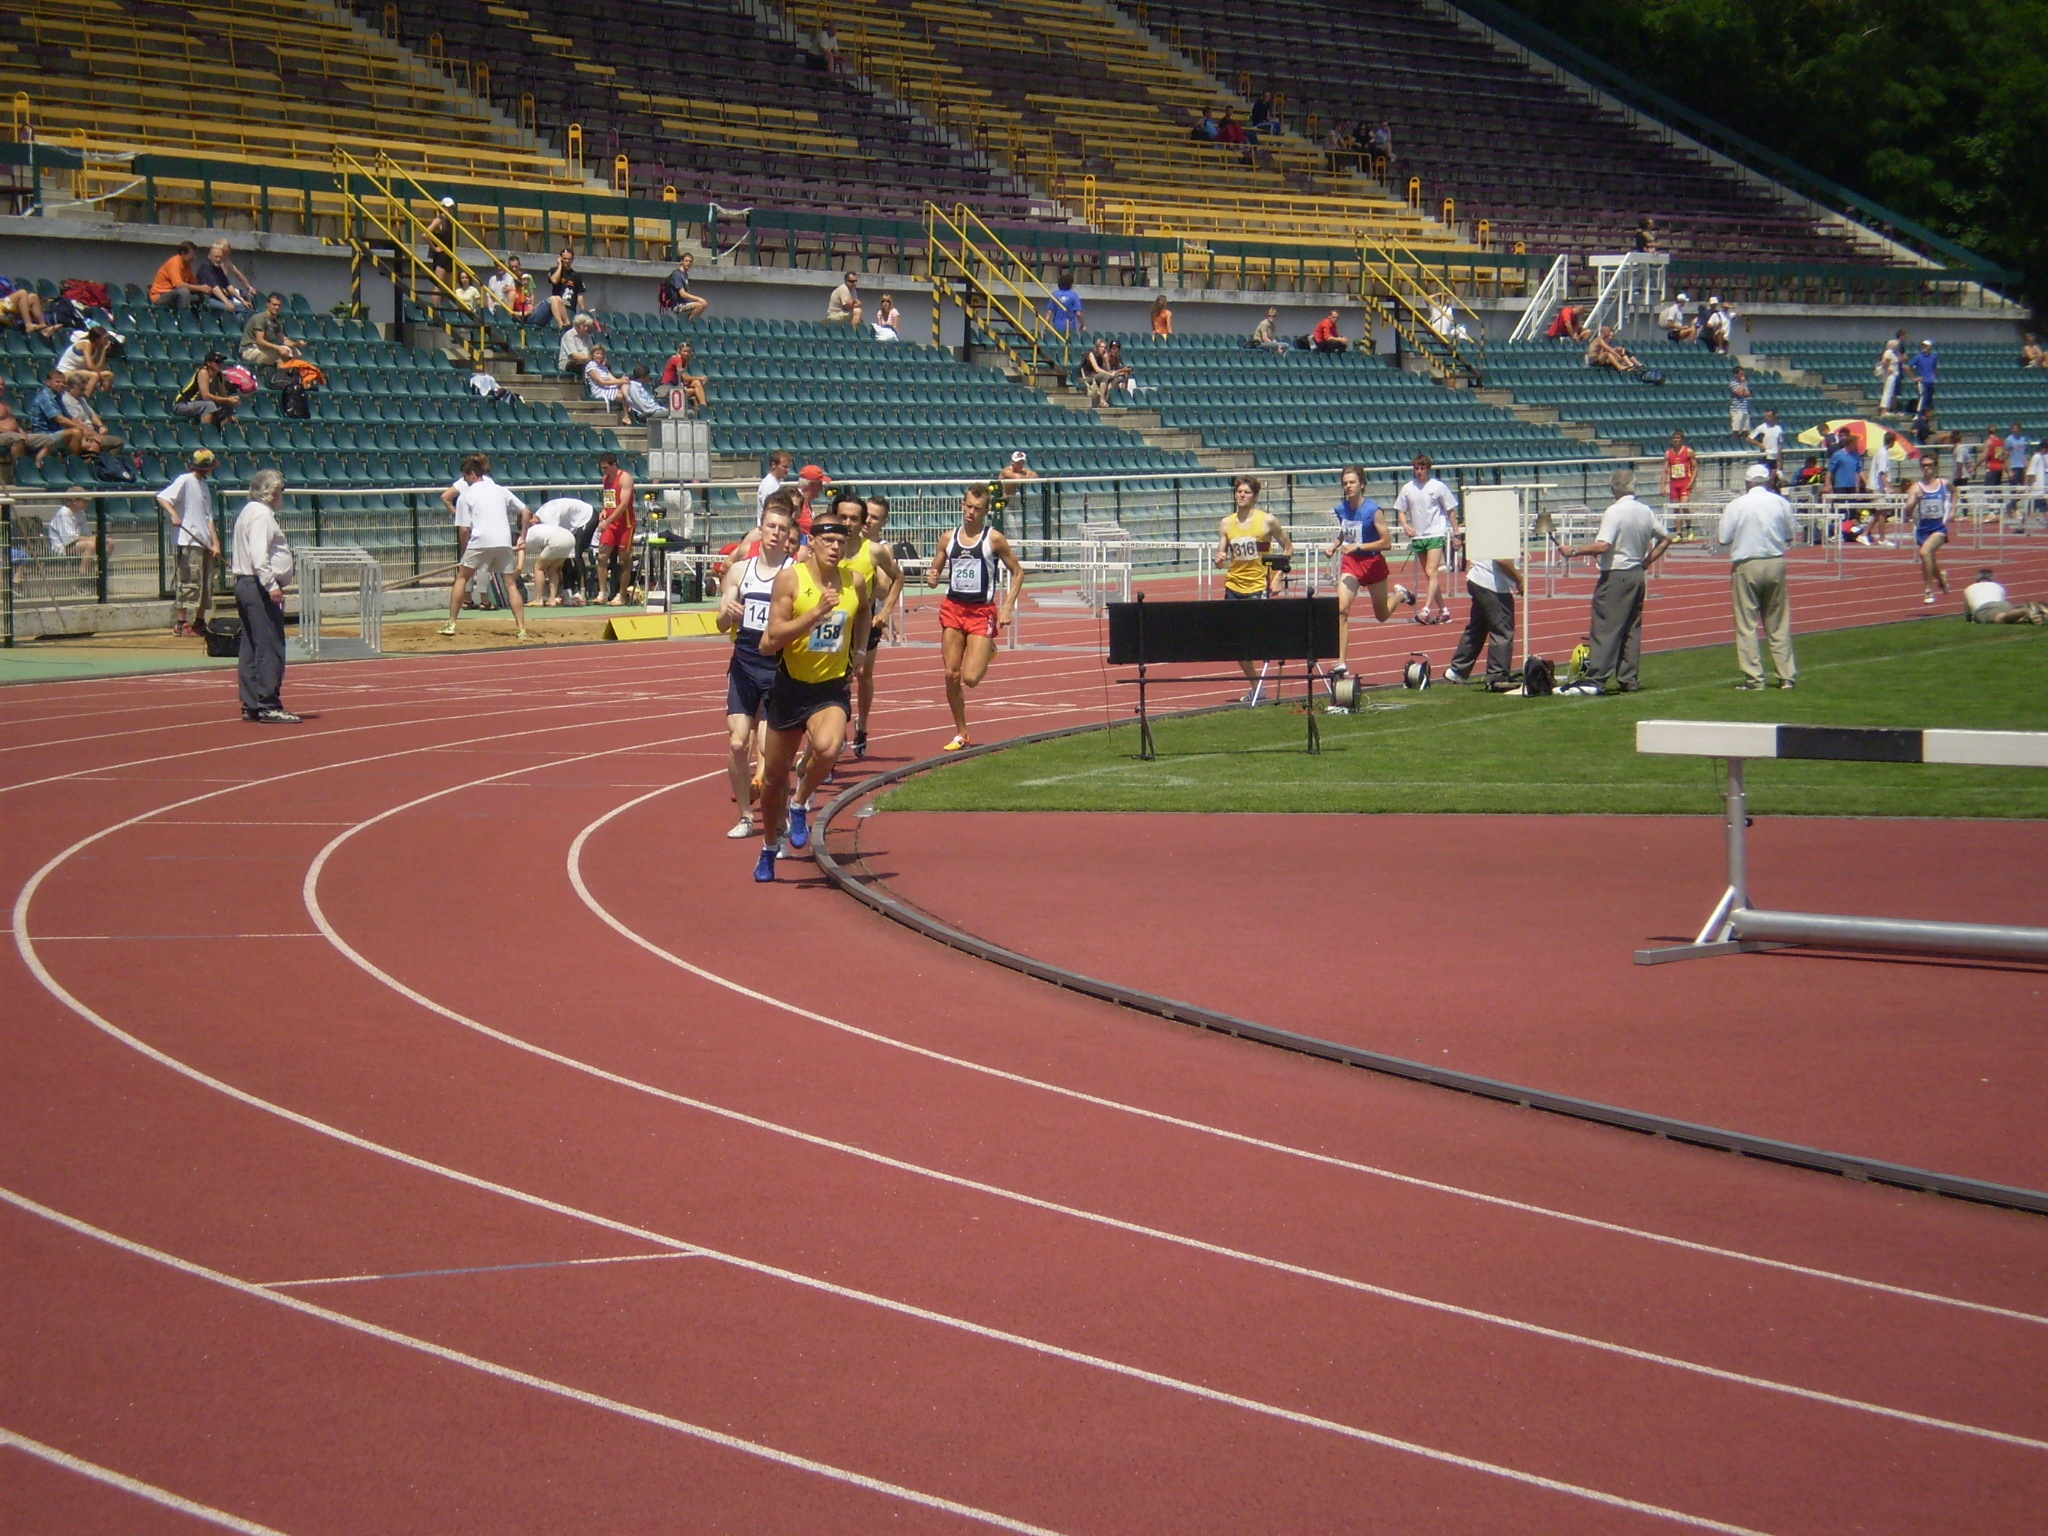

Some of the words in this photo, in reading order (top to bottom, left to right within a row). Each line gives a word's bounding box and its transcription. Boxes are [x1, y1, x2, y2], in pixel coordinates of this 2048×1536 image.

[1234, 541, 1255, 557] 316
[956, 569, 975, 579] 258
[749, 604, 769, 624] 14
[814, 624, 841, 640] 158
